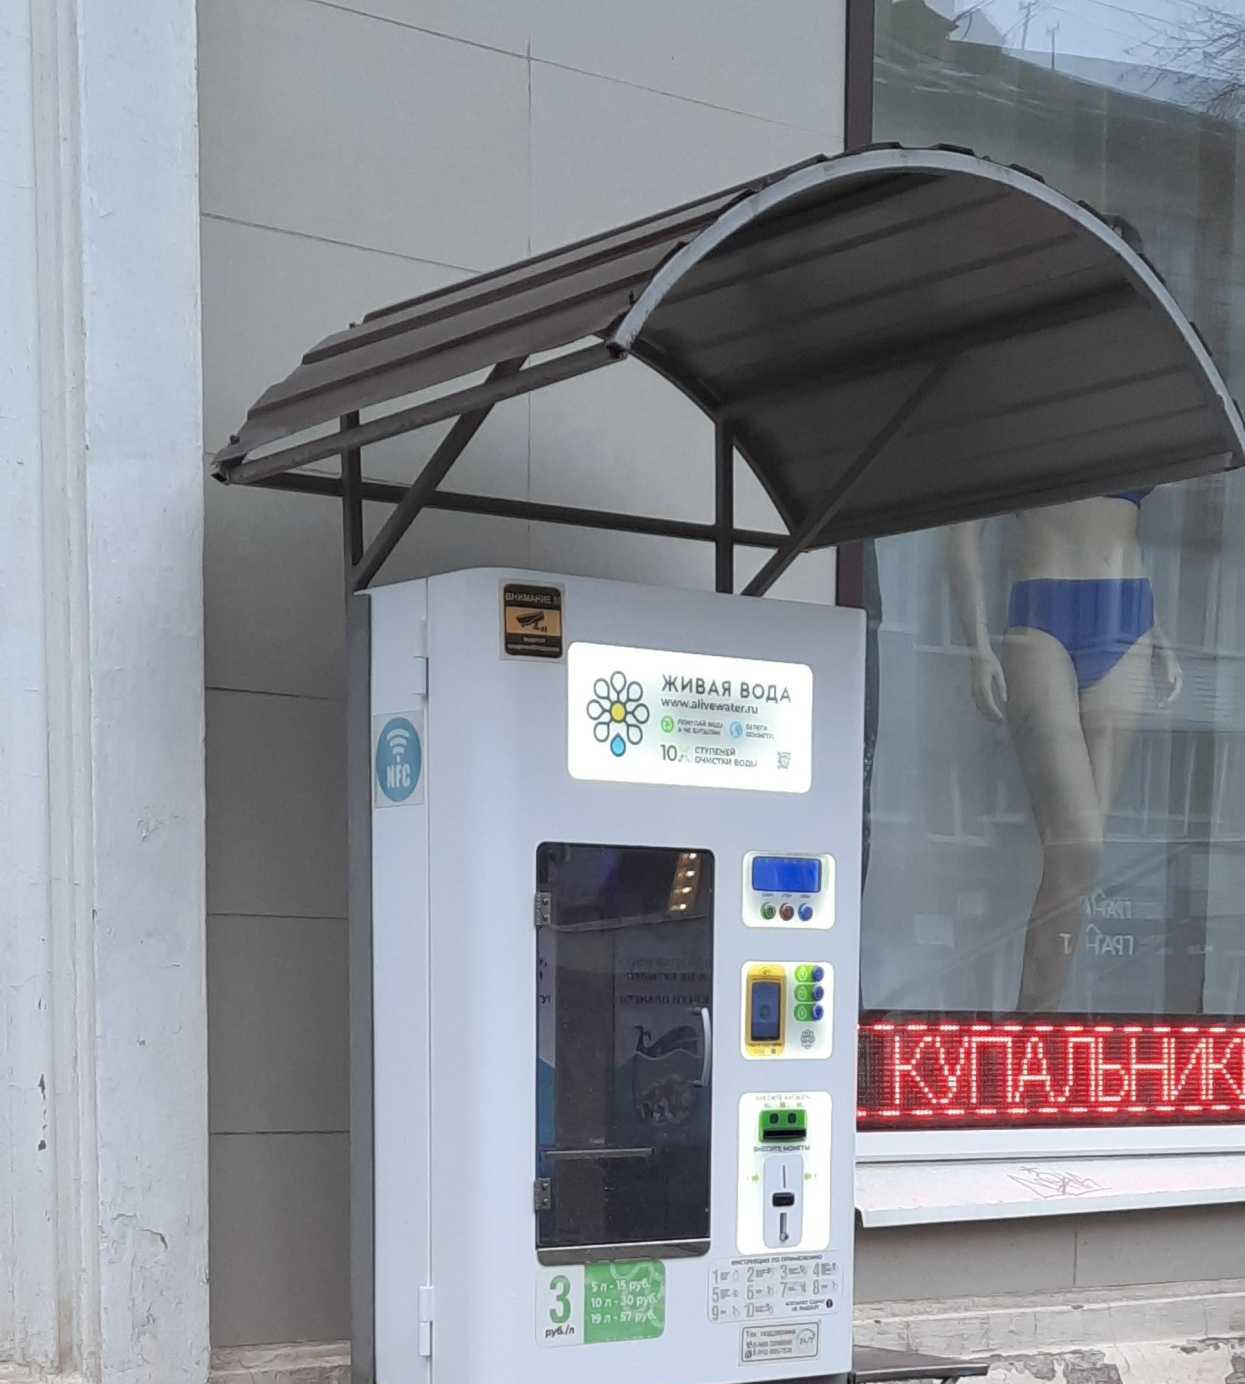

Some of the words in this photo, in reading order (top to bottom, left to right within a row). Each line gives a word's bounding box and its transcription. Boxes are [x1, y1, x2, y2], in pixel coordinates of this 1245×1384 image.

[661, 673, 732, 697] ЖИВАЯ
[740, 681, 791, 704] ВОДА
[660, 698, 758, 714] www.alivewater.ru
[660, 744, 677, 762] 10
[694, 746, 736, 757] СТУПЕНЕЙ
[694, 756, 732, 766] ОЧИСТКИ
[734, 758, 757, 768] ВОДЫ
[386, 763, 411, 789] NFC
[893, 1034, 1245, 1104] КУПАЛЬНИК
[712, 1269, 719, 1285] 1
[746, 1266, 755, 1283] 2
[780, 1264, 788, 1281] 3
[812, 1262, 820, 1278] 4
[591, 1280, 598, 1293] 5
[599, 1282, 607, 1293] л
[616, 1279, 627, 1291] 15
[629, 1277, 651, 1292] руб.
[746, 1284, 754, 1301] 6
[780, 1281, 788, 1298] 7
[812, 1279, 820, 1296] 8
[548, 1274, 572, 1324] 3
[591, 1296, 602, 1309] 10
[603, 1297, 612, 1308] л
[636, 1291, 658, 1307] руб.
[712, 1286, 720, 1304] 5
[591, 1312, 602, 1325] 19
[603, 1314, 611, 1324] л
[620, 1310, 632, 1323] 57
[634, 1307, 657, 1323] руб.
[711, 1304, 719, 1321] 9
[545, 1324, 575, 1338] руб./л
